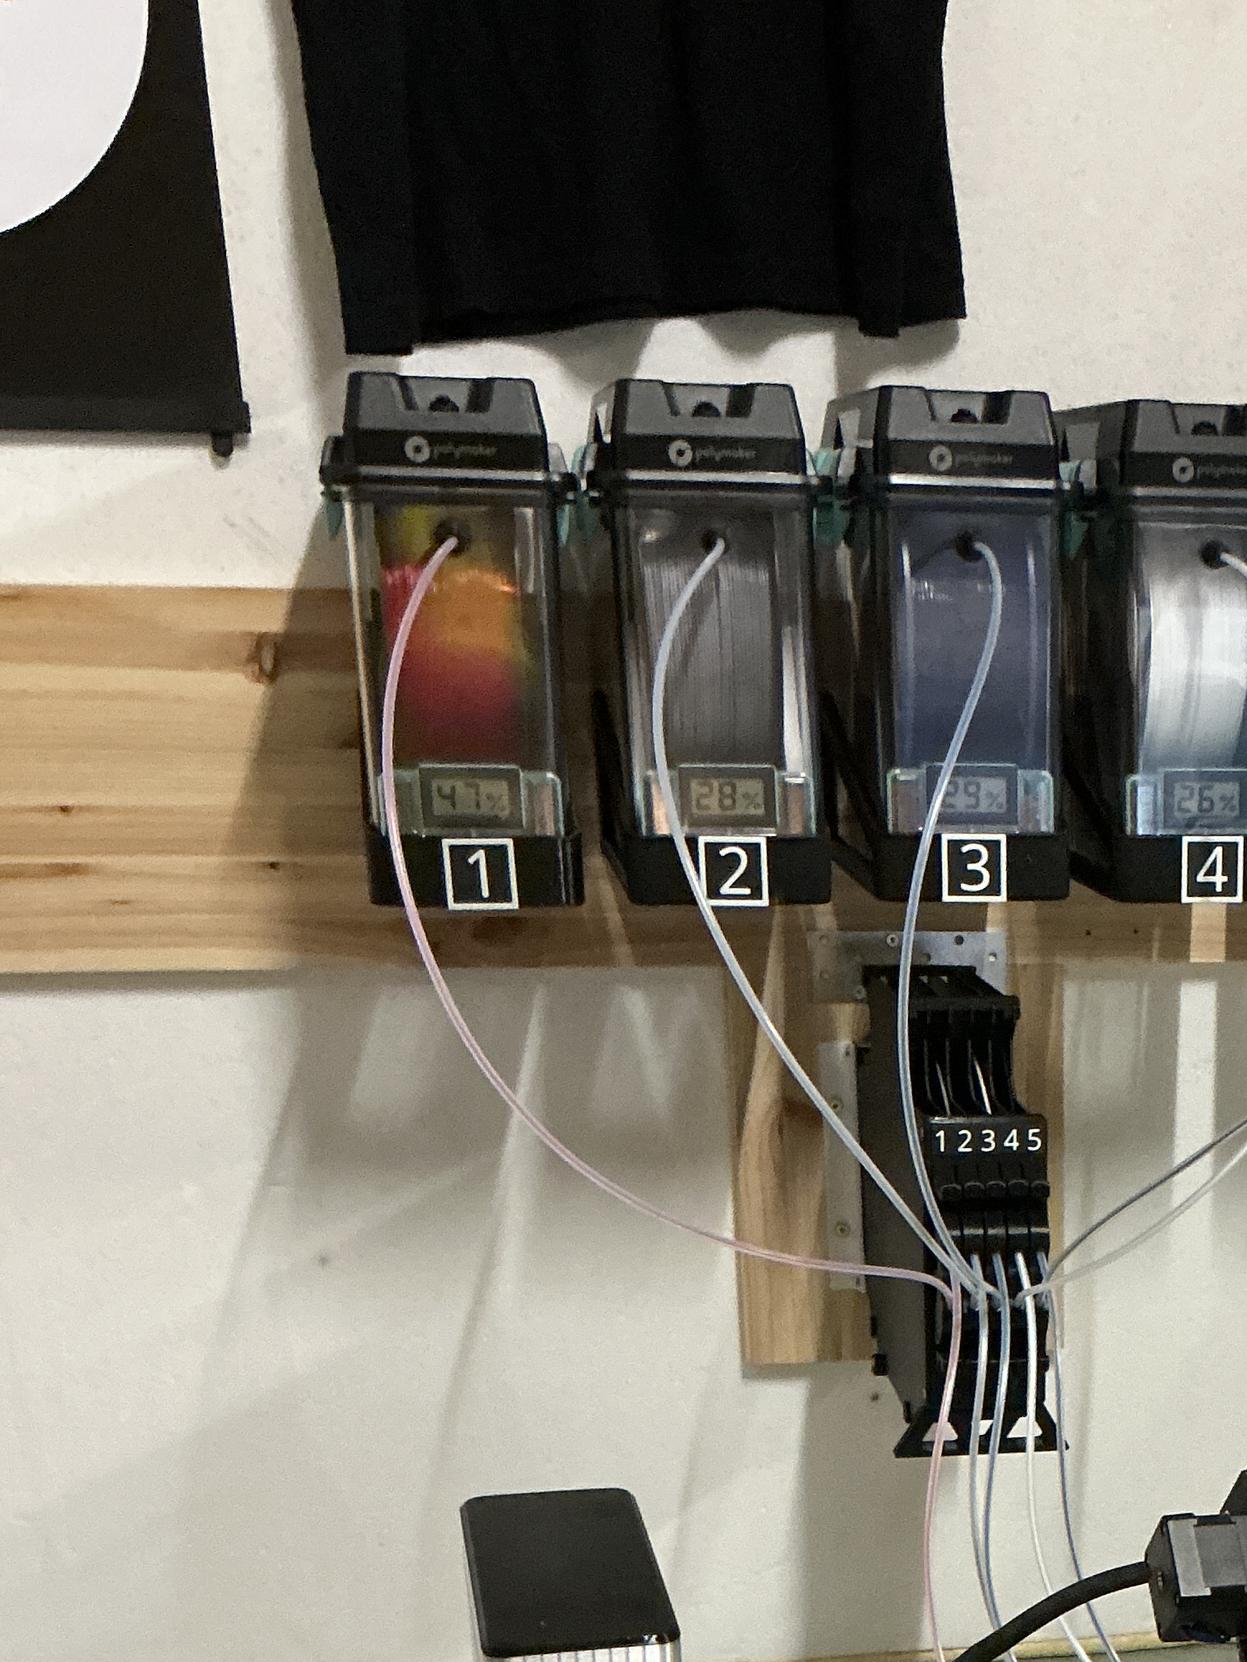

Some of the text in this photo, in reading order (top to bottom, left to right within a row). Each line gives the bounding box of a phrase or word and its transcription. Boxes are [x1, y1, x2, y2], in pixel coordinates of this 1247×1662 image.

[692, 784, 763, 811] 28%
[467, 849, 489, 898] 1
[718, 846, 751, 895] 2
[960, 843, 991, 892] 3
[1196, 846, 1228, 893] 4
[935, 1128, 1042, 1152] 1 2 3 4 5
